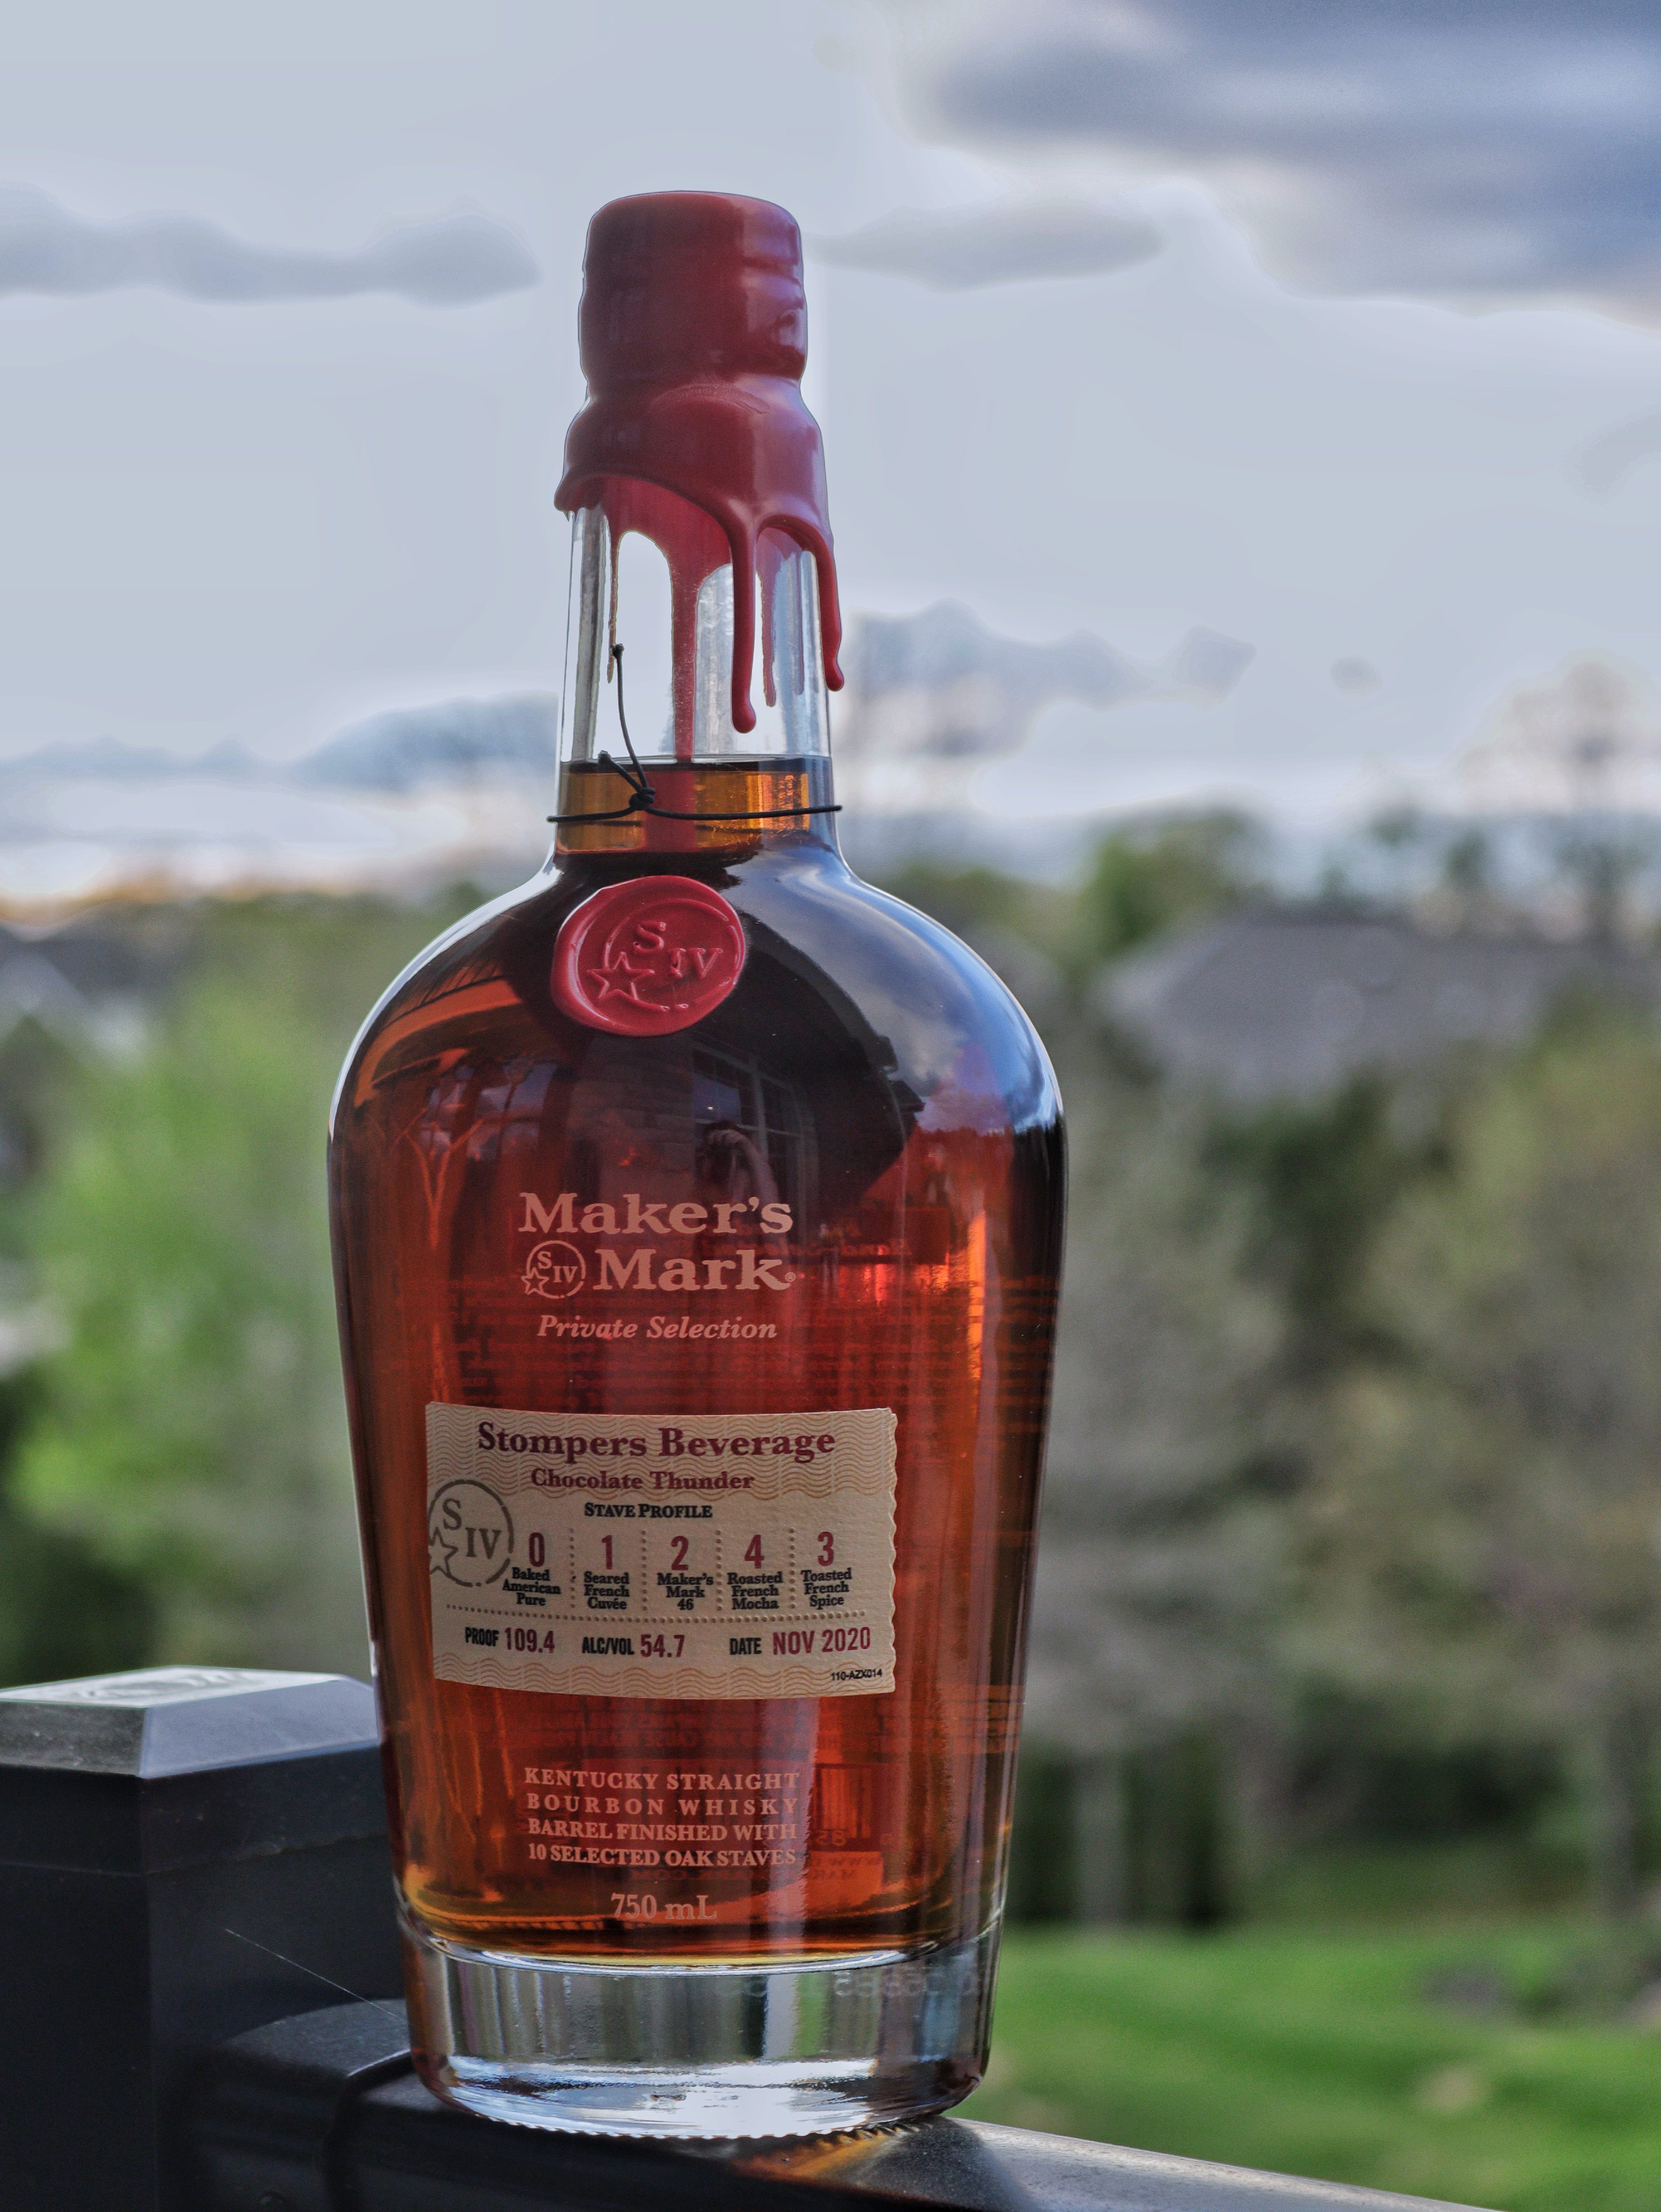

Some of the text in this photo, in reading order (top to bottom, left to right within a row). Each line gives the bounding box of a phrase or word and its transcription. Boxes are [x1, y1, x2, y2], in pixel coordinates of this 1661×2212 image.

[633, 921, 723, 979] S IV
[519, 1192, 794, 1234] Maker's
[537, 1250, 578, 1283] S IV
[537, 1315, 777, 1339] Private Selection
[478, 1422, 835, 1463] Stompers Beverage
[531, 1469, 755, 1489] Chocolate Thunder
[585, 1502, 712, 1518] STAVE PROFILE
[442, 1498, 501, 1559] S IV
[529, 1532, 544, 1567] 0
[600, 1535, 613, 1569] 1
[671, 1536, 688, 1571] 2
[745, 1535, 764, 1568] 4
[818, 1532, 834, 1566] 3
[512, 1568, 549, 1582] Baked
[584, 1572, 630, 1585] Seared
[657, 1573, 714, 1586] Maker's
[728, 1572, 783, 1585] Roasted
[801, 1568, 852, 1583] Toasted
[502, 1581, 561, 1594] American
[584, 1585, 630, 1598] French
[666, 1586, 705, 1598] Mark
[731, 1584, 779, 1598] French
[805, 1581, 849, 1595] French
[517, 1595, 546, 1607] Pure
[588, 1597, 627, 1610] Cuvée
[677, 1598, 694, 1610] 46
[732, 1597, 779, 1610] Mocha
[809, 1595, 845, 1609] Spice
[465, 1627, 555, 1653] PROOF 109.4
[582, 1635, 685, 1657] ALC/VOL 54.7
[730, 1627, 871, 1656] DATE NOV 2020
[525, 1768, 799, 1790] KENTUCKY STRAIGHT
[527, 1793, 799, 1816] BOURBON WHISKY
[528, 1818, 613, 1839] BARREL
[616, 1823, 727, 1841] FINISHED
[734, 1823, 797, 1840] WITH
[529, 1843, 796, 1866] 10 SELECTED OAK STAVES
[611, 1893, 717, 1920] 750 mL
